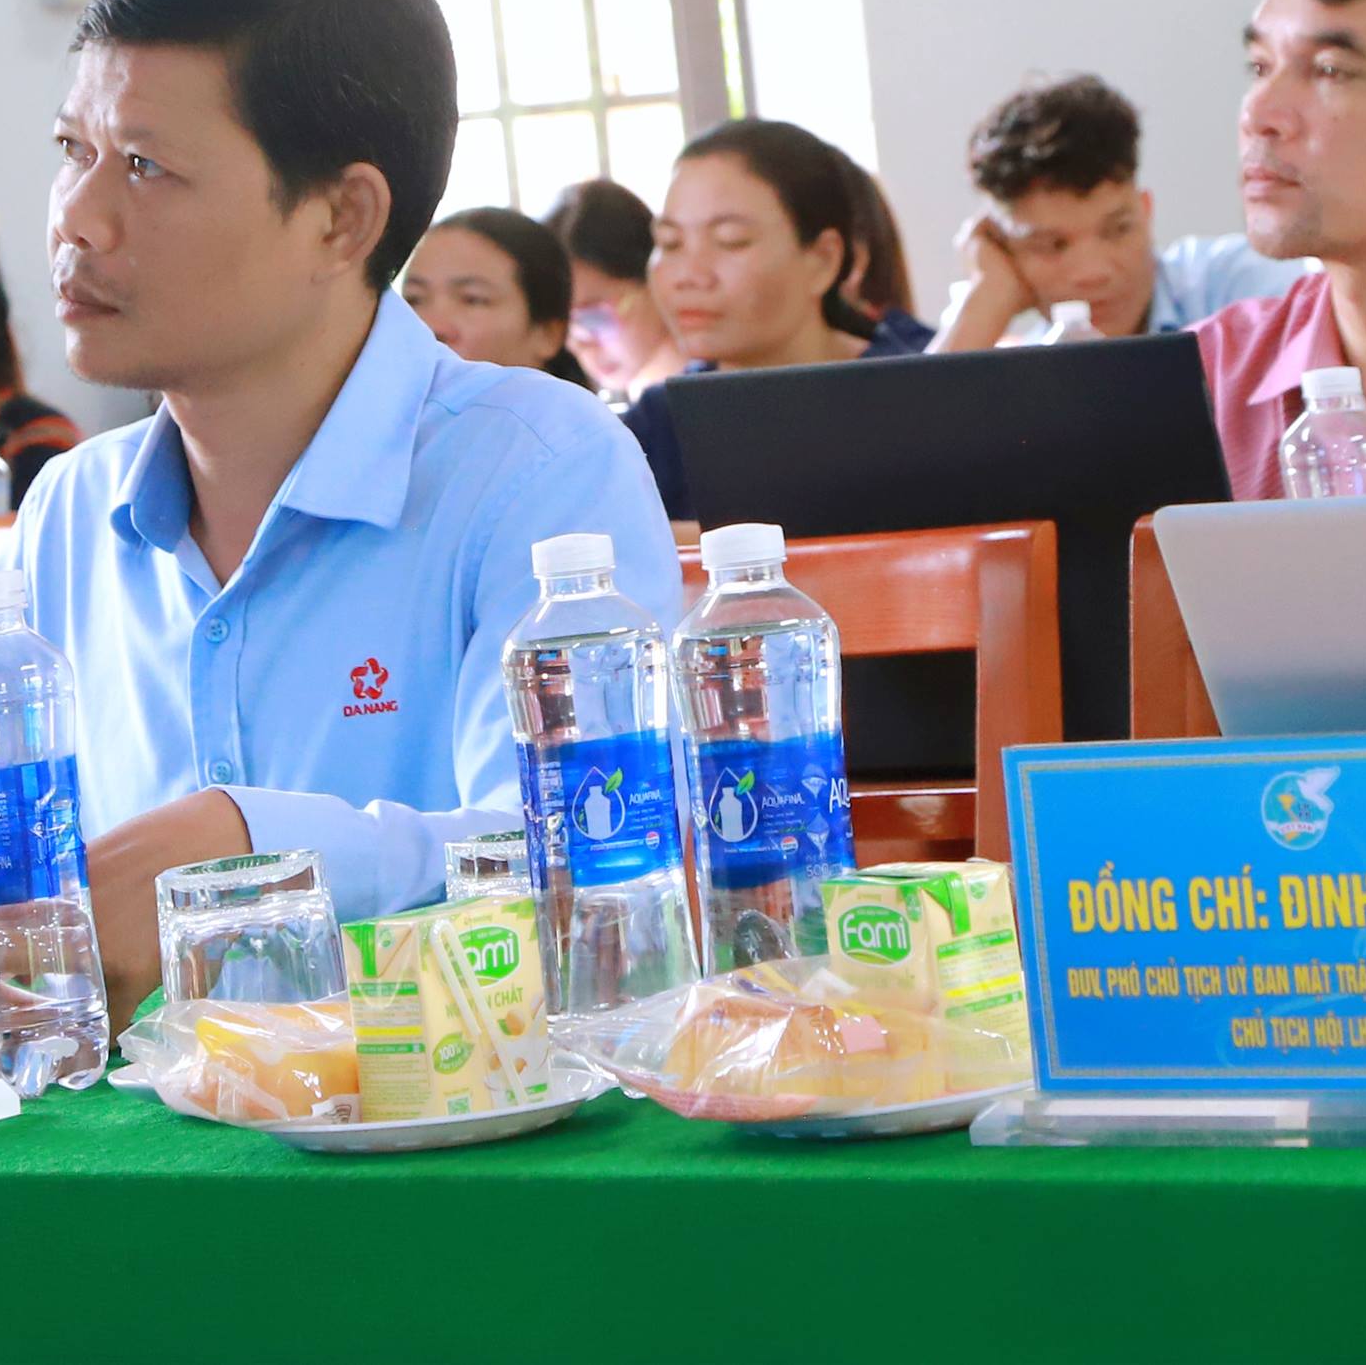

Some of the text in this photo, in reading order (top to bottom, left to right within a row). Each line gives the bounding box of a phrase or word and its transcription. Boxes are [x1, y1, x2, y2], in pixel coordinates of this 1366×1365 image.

[1068, 860, 1178, 933] ĐỒNG
[1188, 864, 1269, 931] CHÍ:
[464, 933, 514, 972] ami
[842, 914, 907, 949] fami
[1106, 960, 1141, 998] PHÓ
[1145, 956, 1180, 997] CHỦ
[1183, 965, 1222, 1003] TỊCH
[1252, 964, 1291, 996] BAN
[1230, 1007, 1268, 1048] CHỦ
[1270, 1017, 1310, 1054] TỊCH
[1313, 1010, 1345, 1054] HỘI
